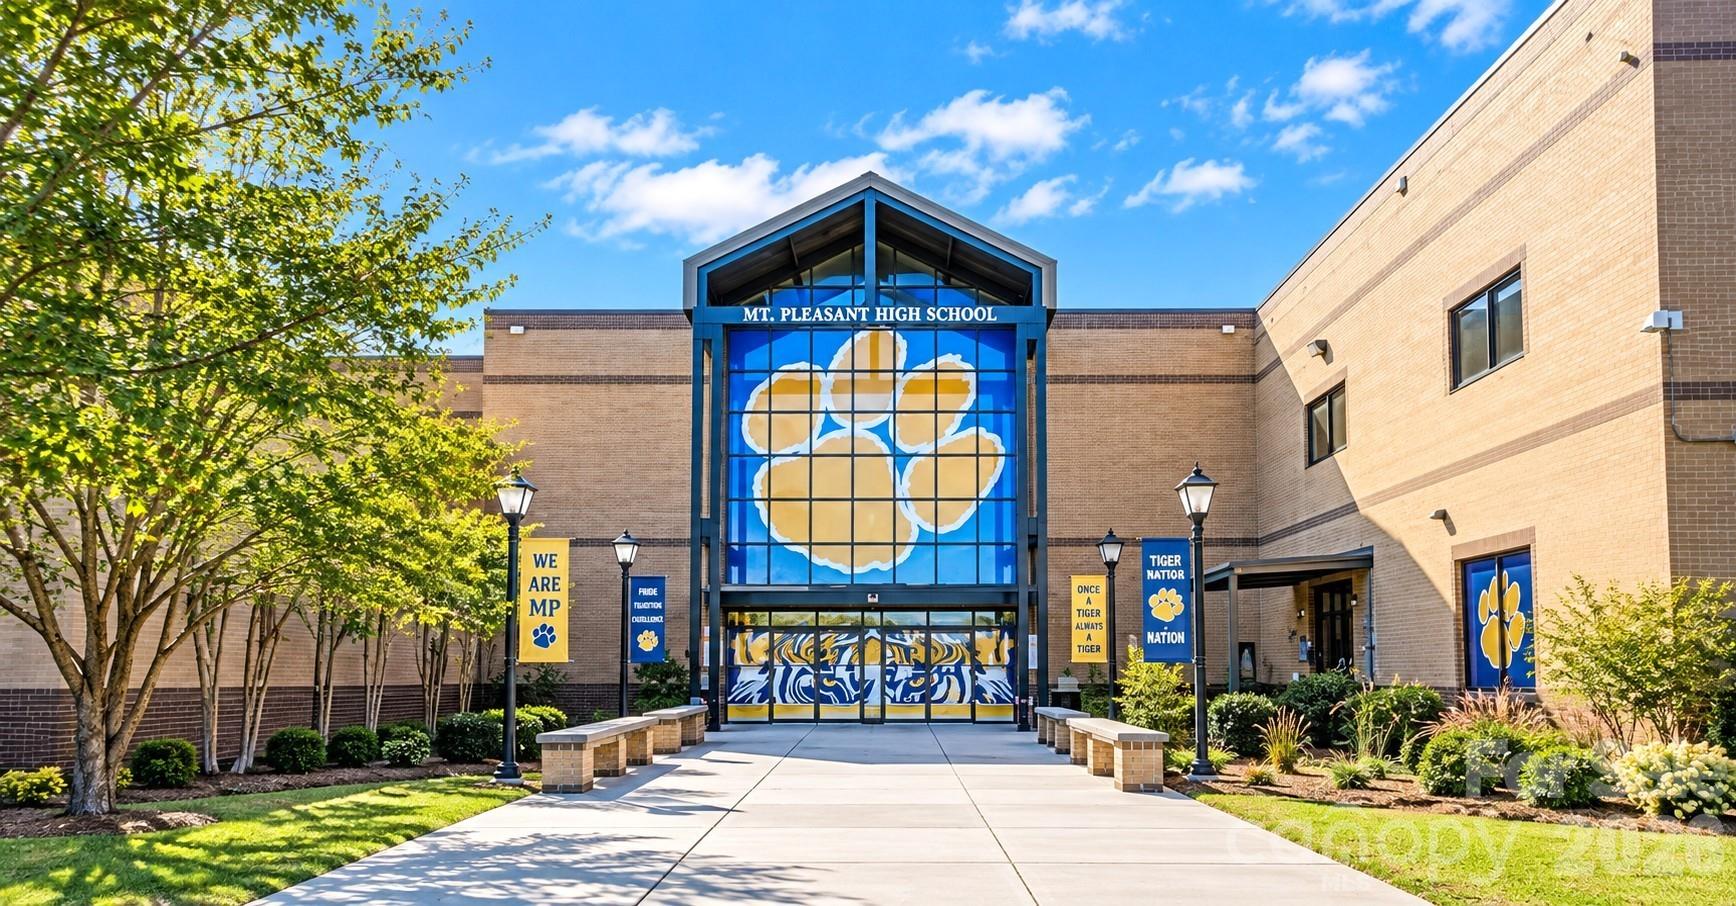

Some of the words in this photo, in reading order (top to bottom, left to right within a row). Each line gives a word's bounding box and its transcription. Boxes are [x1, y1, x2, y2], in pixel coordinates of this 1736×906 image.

[743, 307, 775, 322] MT.
[780, 307, 870, 322] PLEASANT
[874, 307, 922, 322] HIGH
[926, 307, 998, 322] SCHOOL
[533, 553, 558, 569] WE
[1149, 554, 1182, 567] TIGER
[528, 576, 561, 592] ARE
[1077, 585, 1101, 594] ONCE
[529, 598, 561, 617] MP
[1086, 597, 1092, 605] A
[1076, 609, 1101, 618] TIGER
[1086, 633, 1092, 642] A
[1147, 631, 1185, 644] NATION
[1077, 645, 1101, 654] TIGER
